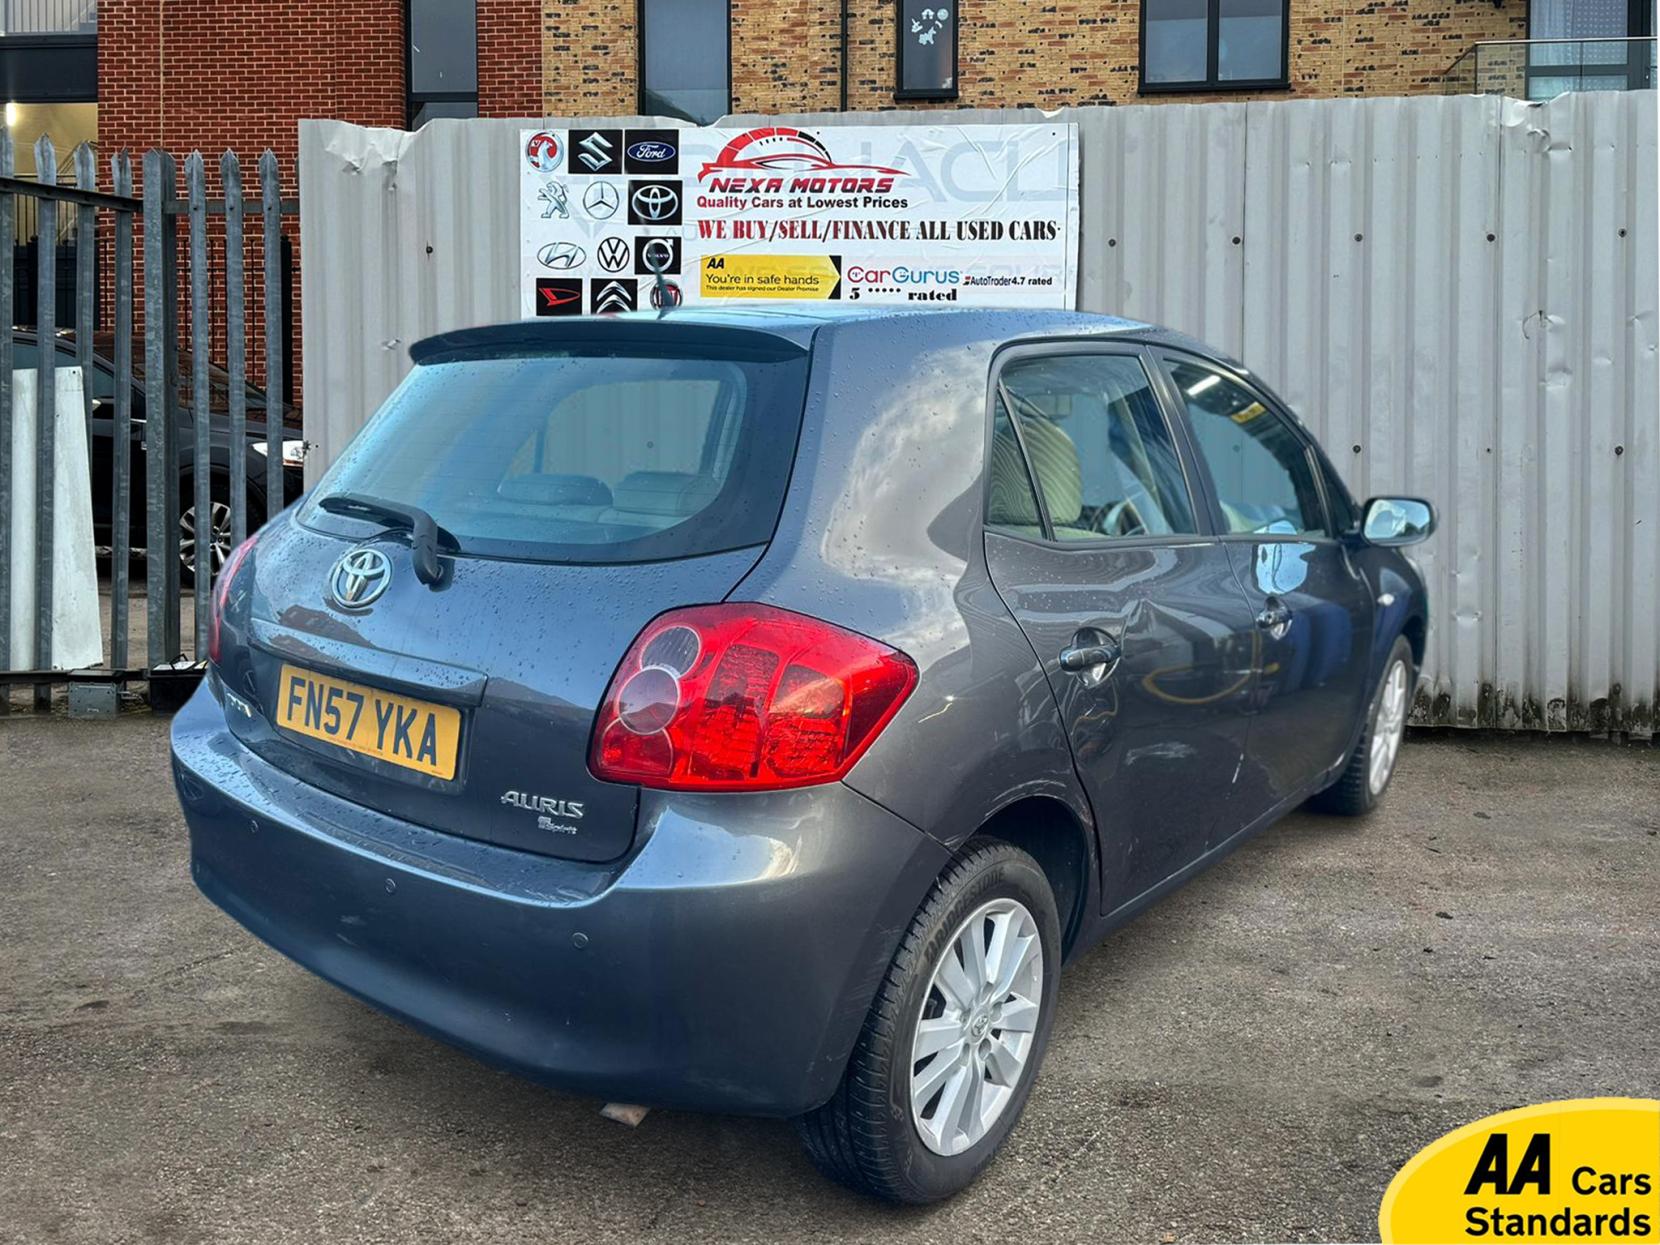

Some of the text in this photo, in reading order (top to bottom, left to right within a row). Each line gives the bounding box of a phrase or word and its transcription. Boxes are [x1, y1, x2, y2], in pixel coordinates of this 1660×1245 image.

[636, 144, 666, 159] Ford
[709, 178, 894, 193] NEXA MOTORS
[697, 196, 908, 210] Quality Cars at Lowest Prices
[698, 220, 727, 240] WE
[916, 221, 951, 240] ALL
[957, 221, 1004, 240] USED
[706, 257, 725, 269] AA
[706, 273, 820, 285] You're in safe hands
[847, 266, 960, 284] CarGurus
[1011, 277, 1025, 285] 4.7
[1028, 277, 1052, 285] rated
[849, 288, 957, 301] 5 rated
[287, 676, 436, 766] FN57 YKA
[501, 790, 583, 819] AURIS
